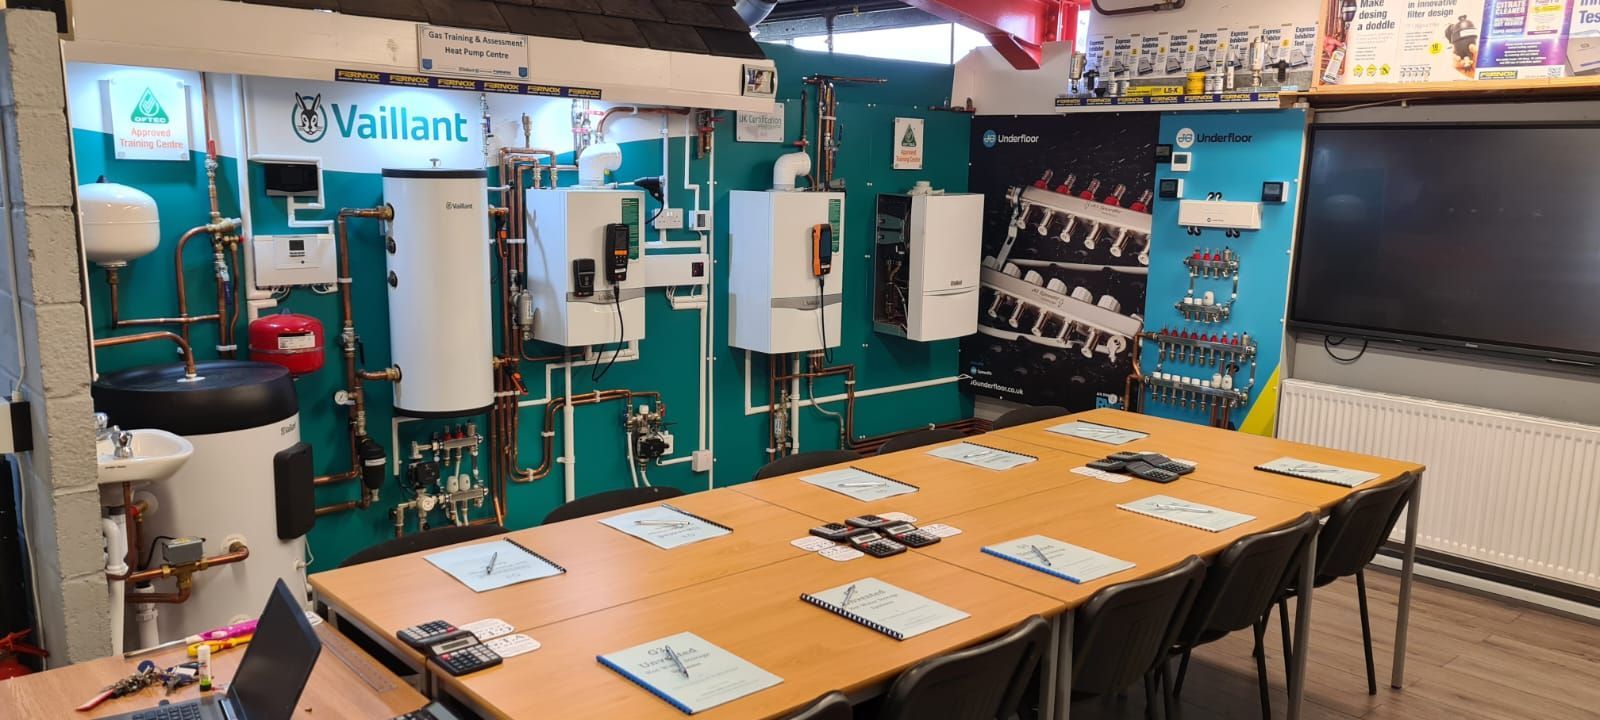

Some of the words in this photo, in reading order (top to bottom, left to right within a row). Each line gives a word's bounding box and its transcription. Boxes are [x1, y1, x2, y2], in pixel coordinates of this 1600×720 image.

[1359, 10, 1387, 20] dosing
[1408, 9, 1425, 18] filter
[1427, 8, 1454, 18] design
[1357, 23, 1363, 31] a
[1365, 20, 1396, 31] doddle
[428, 31, 443, 40] Gas
[444, 33, 474, 44] Training
[483, 36, 523, 48] Assessment
[445, 46, 463, 55] Heat
[464, 48, 485, 58] Pump
[486, 50, 510, 59] Centre
[134, 116, 167, 124] OFTEC
[331, 103, 469, 142] Vaillant
[131, 128, 171, 138] Approved
[1197, 132, 1253, 144] Underfloor
[120, 138, 155, 150] Training
[156, 139, 185, 149] Centre
[998, 134, 1040, 144] Underfloor
